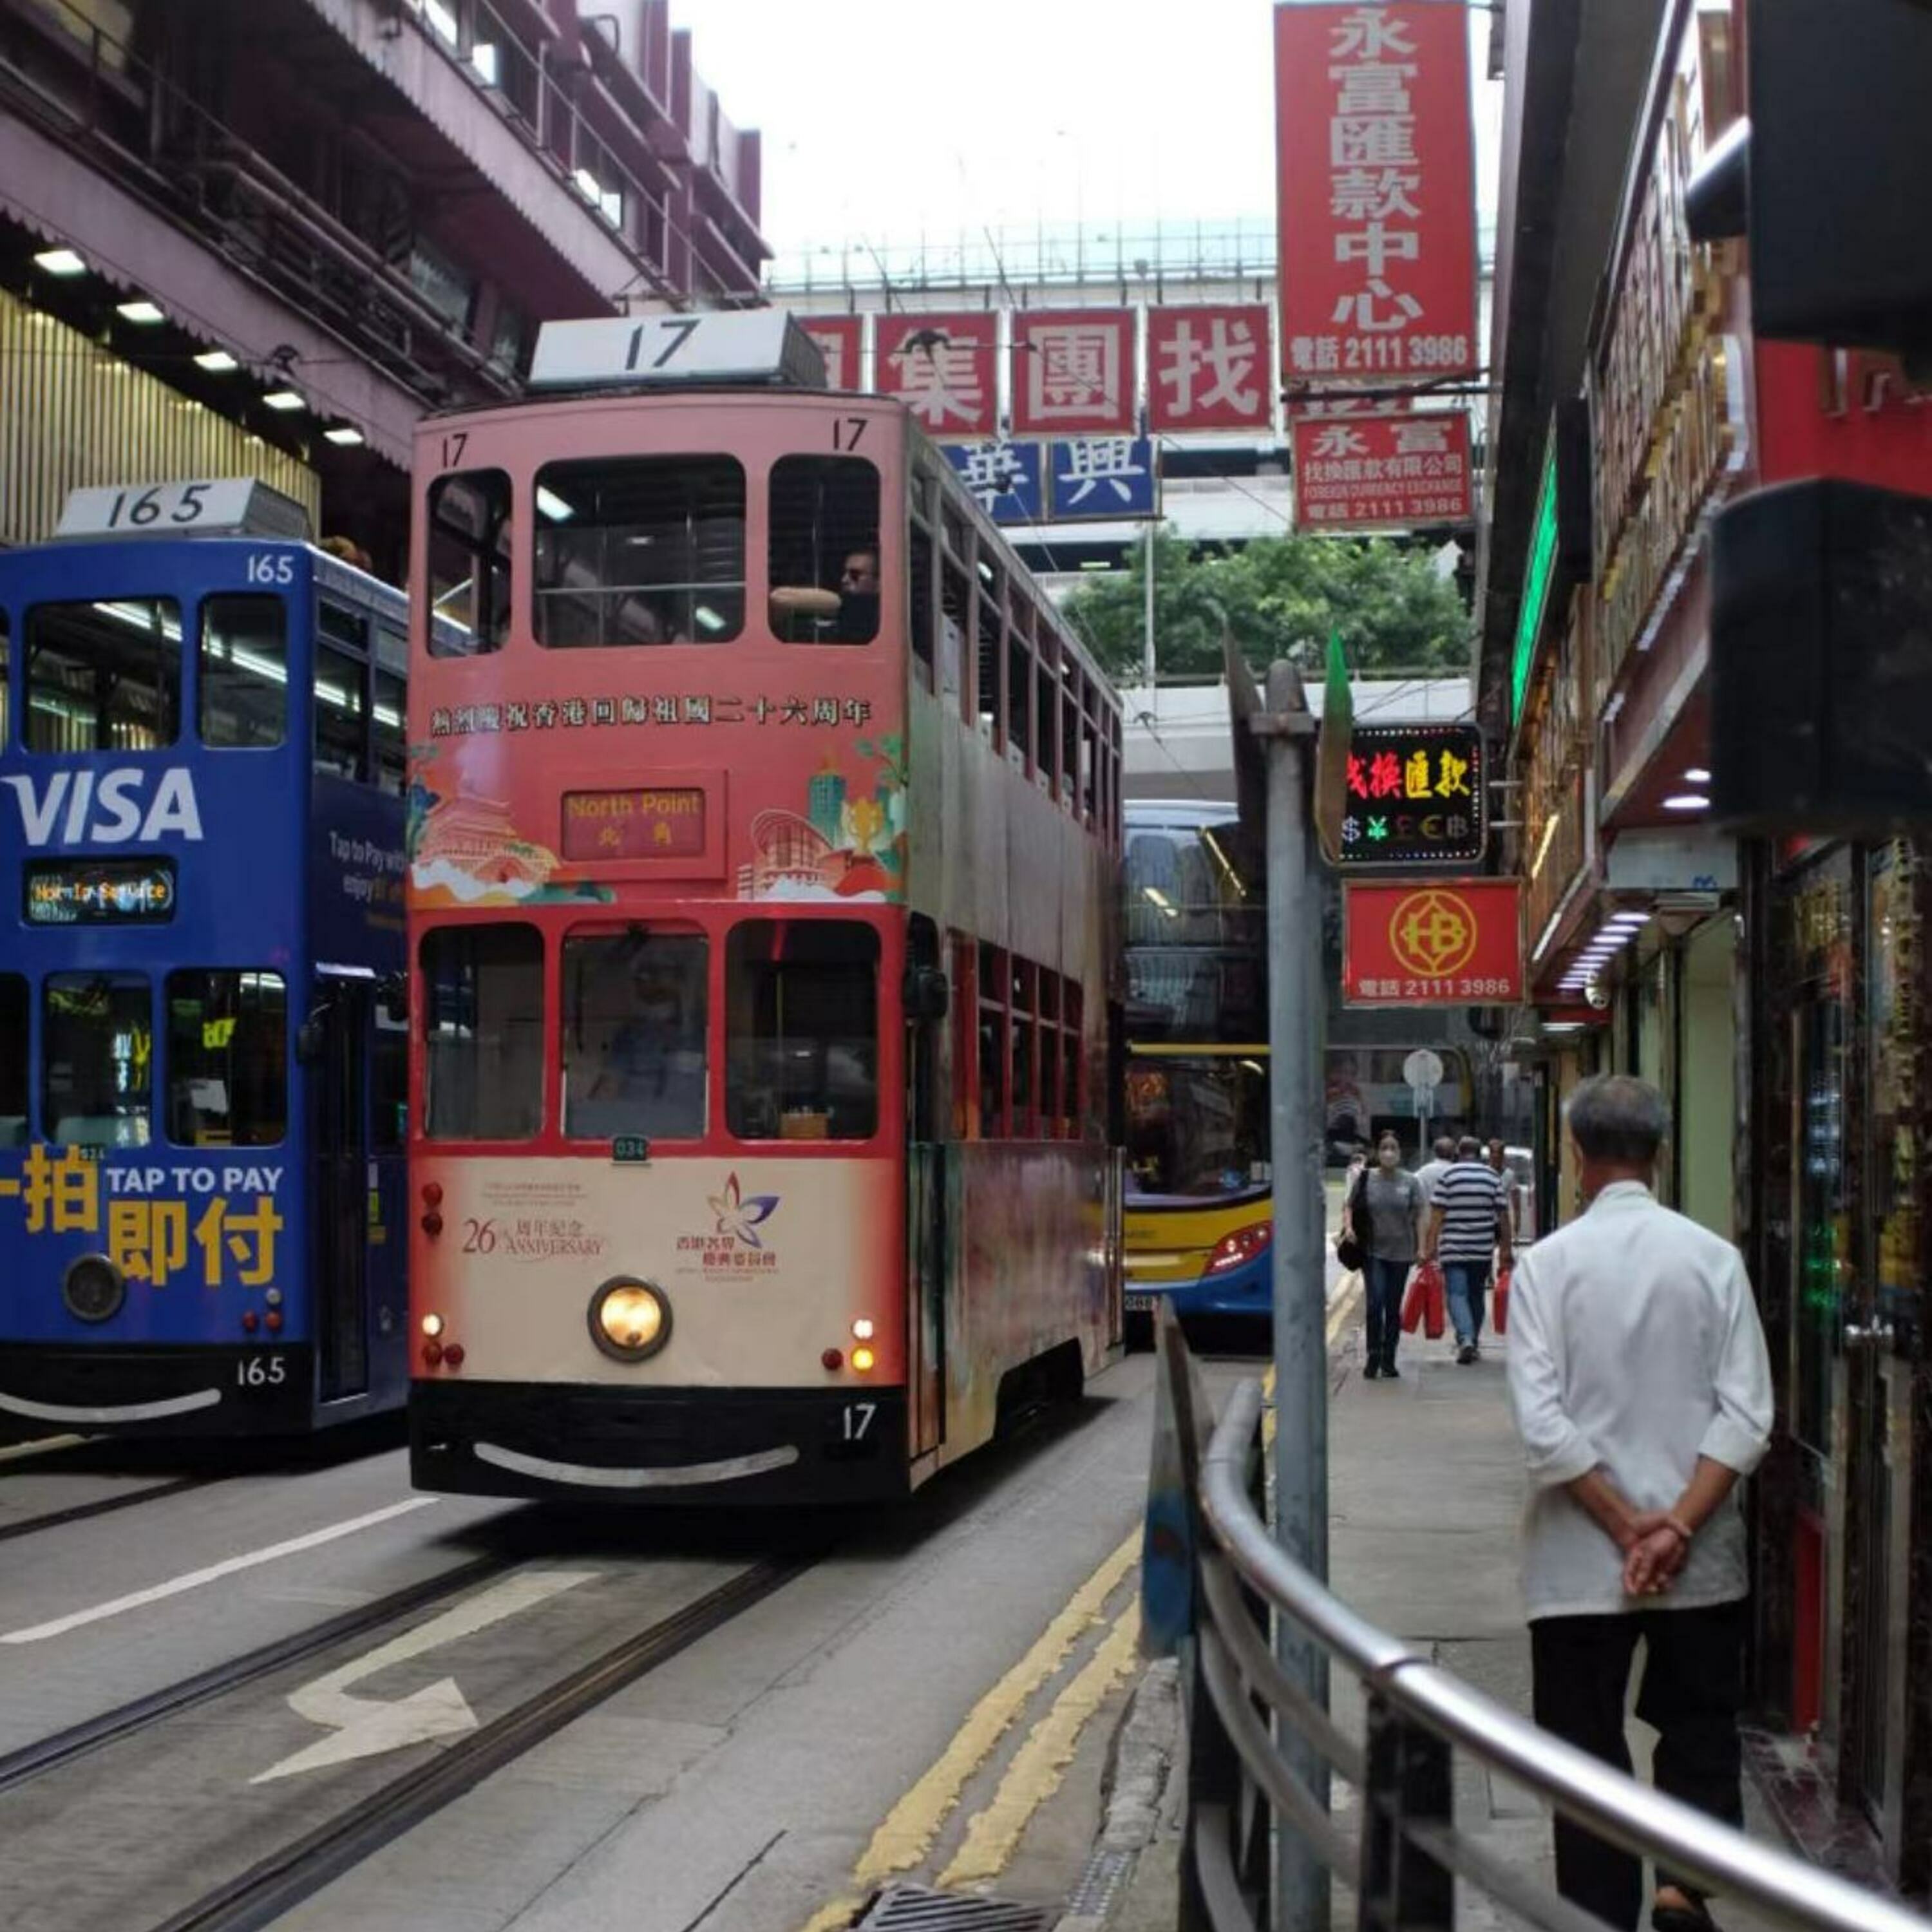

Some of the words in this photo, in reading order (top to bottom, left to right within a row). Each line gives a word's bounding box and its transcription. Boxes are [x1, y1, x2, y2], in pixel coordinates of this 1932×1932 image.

[625, 319, 701, 371] 17
[1291, 336, 1340, 370] 電話
[1345, 336, 1403, 368] 2111
[1408, 335, 1468, 365] 3986
[442, 434, 469, 468] 17
[833, 419, 867, 451] 17
[108, 484, 211, 528] 165
[1354, 500, 1404, 516] 2111
[1412, 498, 1463, 513] 3986
[249, 556, 294, 583] 165
[1, 768, 204, 846] VISA
[567, 795, 633, 817] North
[643, 791, 700, 815] Point
[1406, 979, 1453, 996] 2111
[1461, 978, 1510, 994] 3986
[106, 1168, 164, 1192] TAP
[172, 1168, 215, 1192] TO
[223, 1168, 283, 1192] PAY
[109, 1197, 283, 1285] 即付
[462, 1218, 497, 1253] 26
[238, 1357, 285, 1385] 165
[844, 1403, 876, 1440] 17
